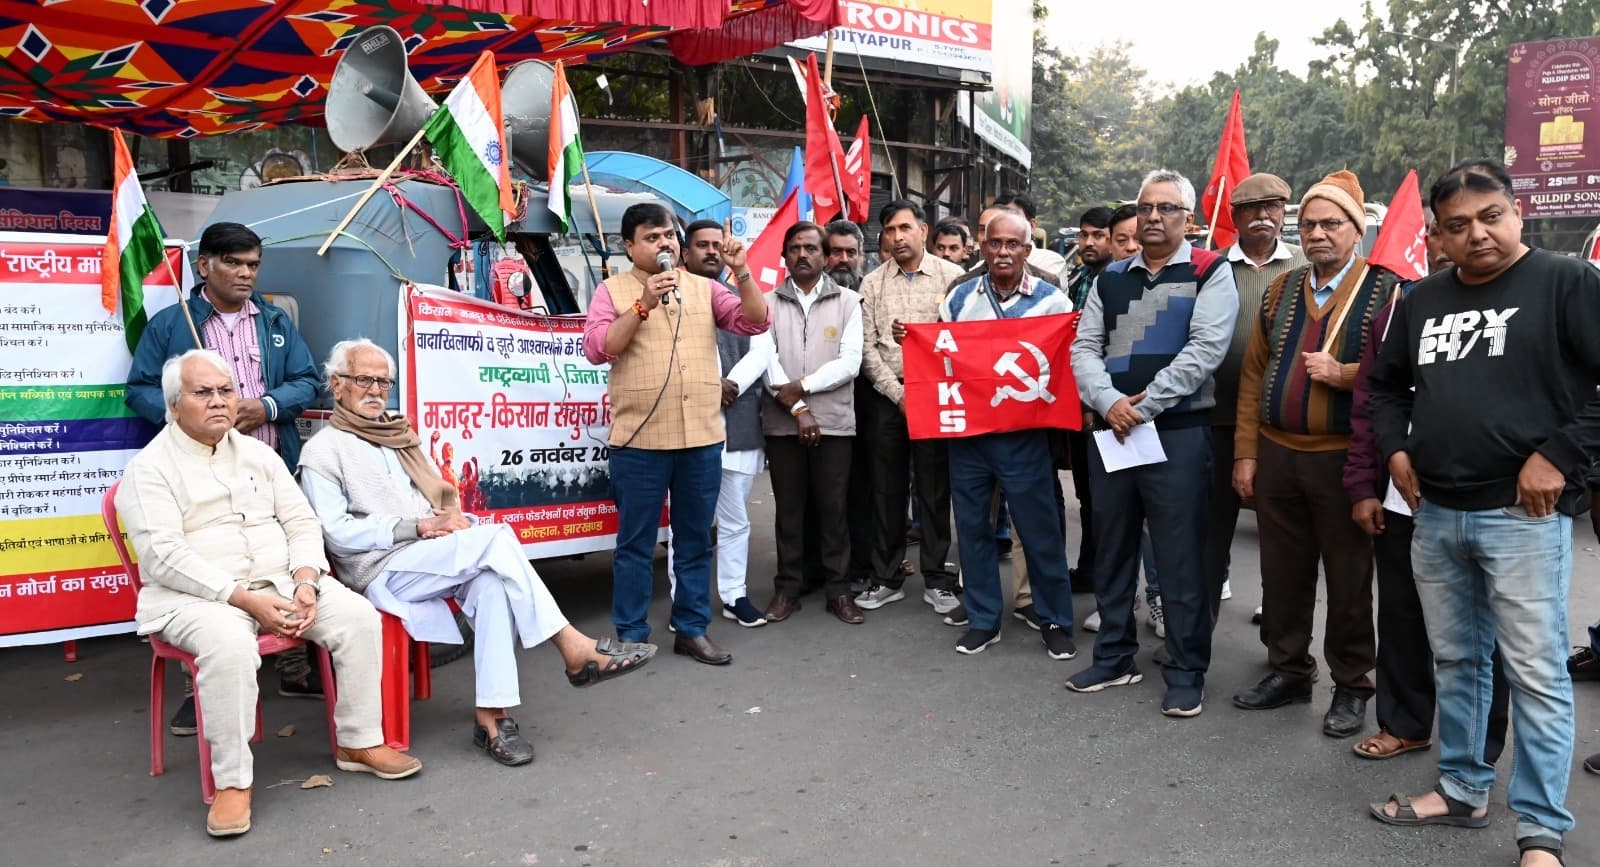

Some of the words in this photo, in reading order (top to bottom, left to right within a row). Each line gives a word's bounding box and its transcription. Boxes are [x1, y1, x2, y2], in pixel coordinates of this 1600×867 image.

[840, 1, 979, 44] RONICS
[1541, 75, 1569, 84] KULDIP
[1570, 73, 1590, 81] SONS
[1537, 94, 1562, 107] सोना
[1564, 91, 1590, 105] जीतो
[1530, 193, 1572, 205] KULDIP
[60, 210, 101, 231] दिवस
[11, 320, 55, 332] सामाजिक
[57, 323, 82, 334] सुरक्षा
[416, 328, 483, 352] वादाखिलाफी
[487, 336, 495, 352] व
[496, 333, 515, 359] झूठे
[564, 337, 574, 356] के
[14, 368, 58, 382] सुनिश्चित
[478, 362, 551, 388] राष्ट्रव्यापी
[564, 363, 600, 385] जिला
[553, 393, 598, 440] संयुक्त
[501, 448, 523, 466] 26
[529, 442, 586, 465] नवंबर
[15, 456, 58, 469] सुनिश्चित
[8, 473, 31, 483] प्रीपेड
[34, 471, 57, 481] स्मार्ट
[59, 470, 81, 481] मीटर
[83, 469, 97, 479] बंद
[98, 468, 117, 480] किए
[16, 489, 50, 499] रोककर
[52, 485, 82, 498] महंगाई
[84, 487, 96, 496] पर
[11, 504, 32, 517] वृद्धि
[526, 508, 561, 522] फेडरेशनों
[562, 507, 575, 520] एवं
[563, 520, 603, 535] झारखण्ड
[28, 537, 42, 548] एवं
[45, 534, 76, 546] भाषाओं
[78, 533, 88, 543] के
[89, 531, 105, 543] प्रति
[16, 576, 57, 596] मोर्चा
[60, 577, 85, 592] का
